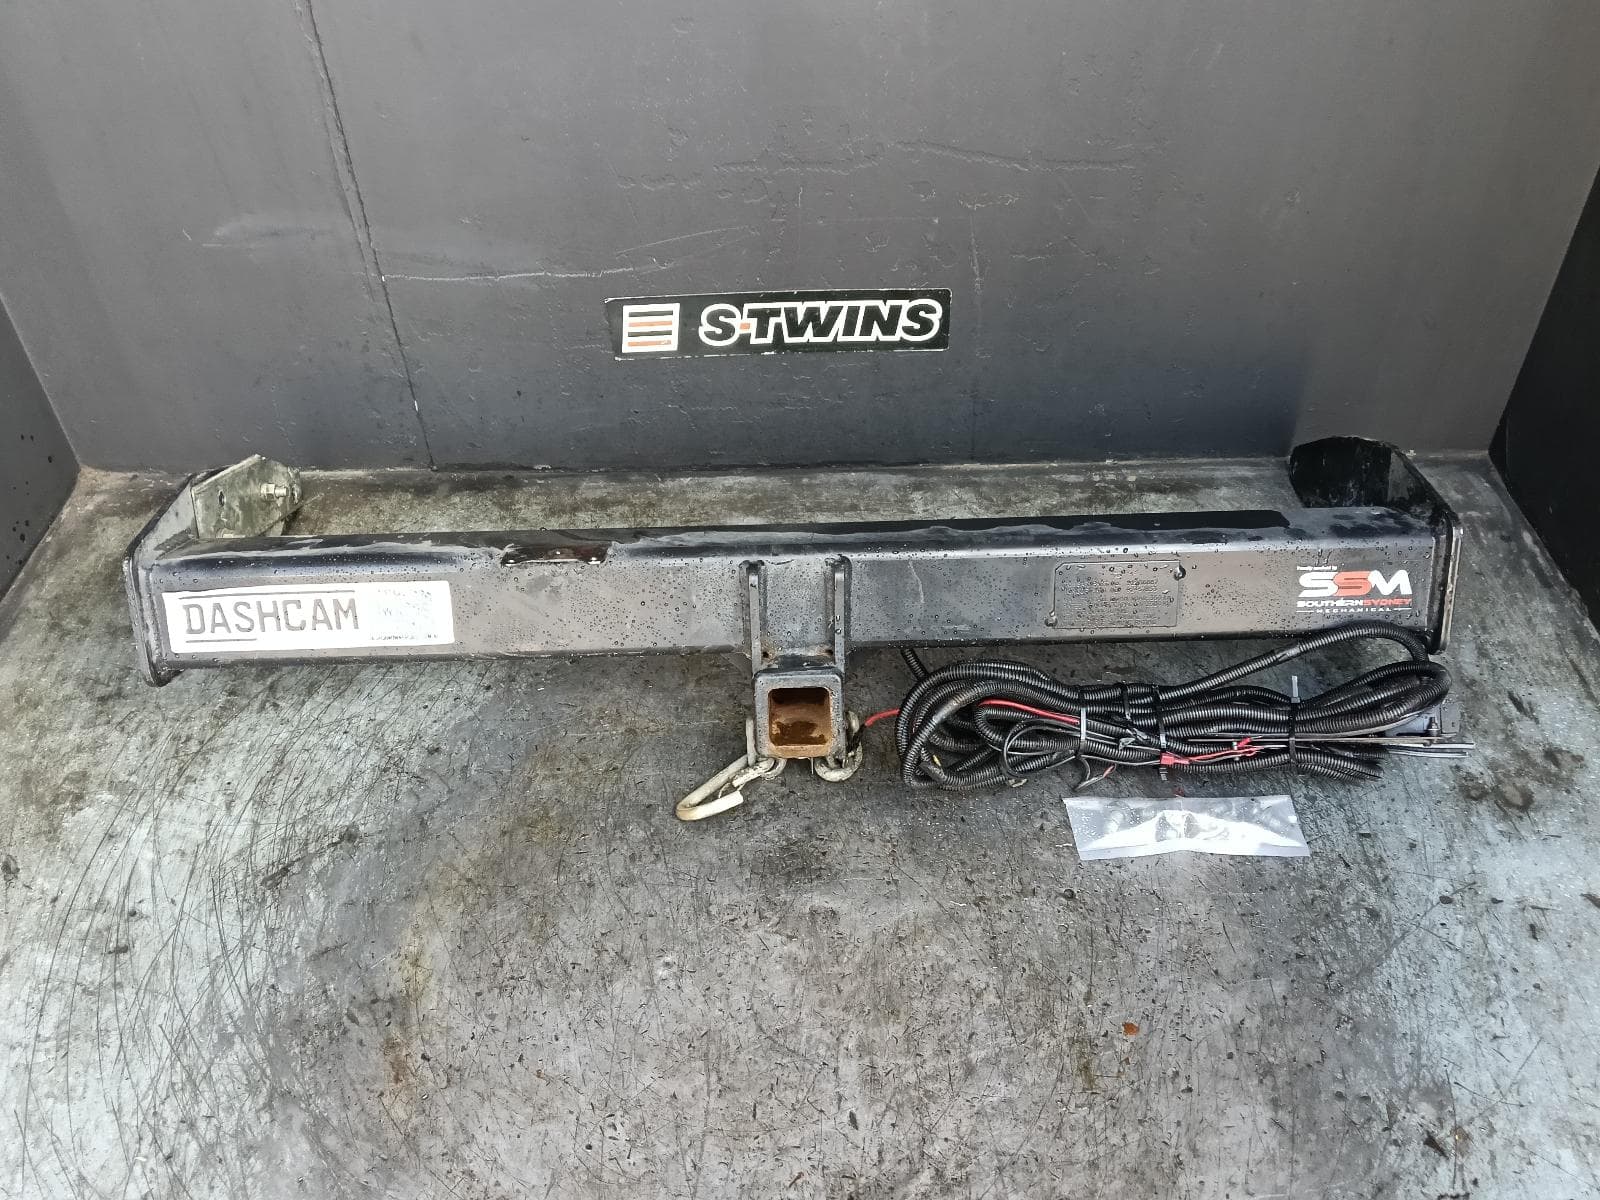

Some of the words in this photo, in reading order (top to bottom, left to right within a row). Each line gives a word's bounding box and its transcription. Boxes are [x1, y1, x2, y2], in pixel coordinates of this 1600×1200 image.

[699, 299, 943, 346] S-TWINS
[1298, 569, 1413, 597] SSM
[182, 598, 360, 635] DASHCAM
